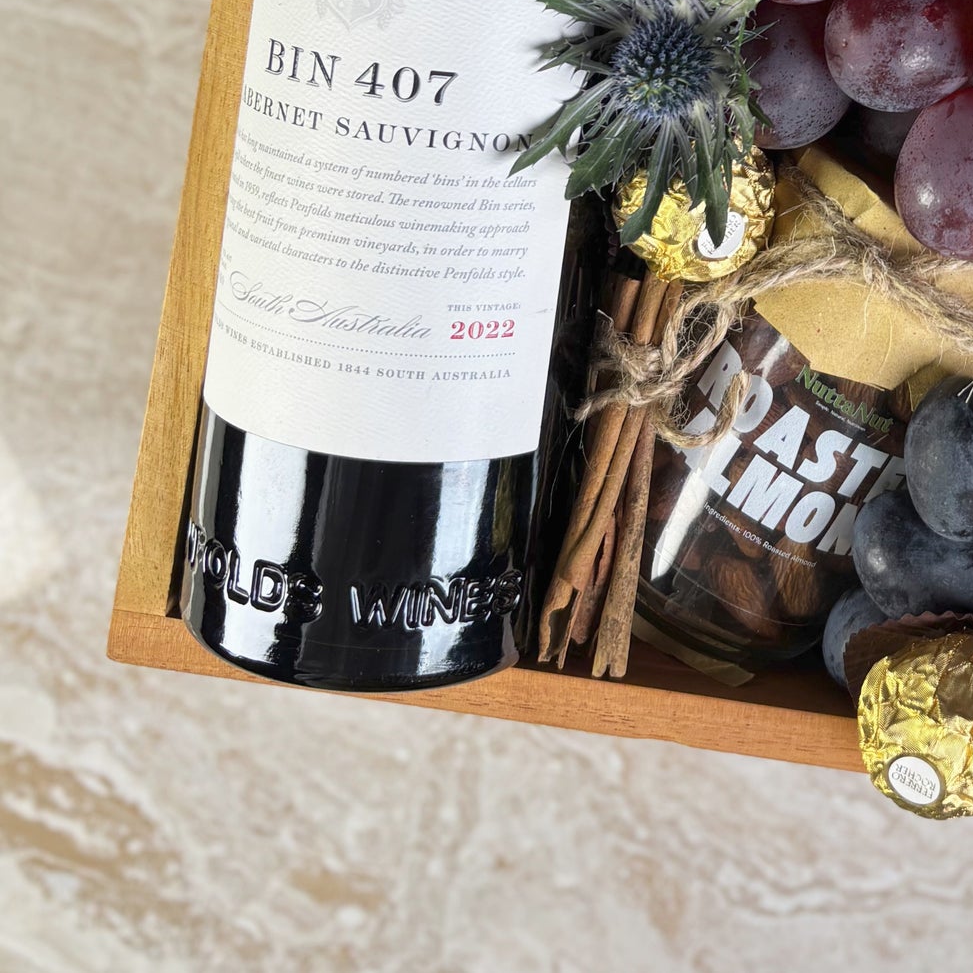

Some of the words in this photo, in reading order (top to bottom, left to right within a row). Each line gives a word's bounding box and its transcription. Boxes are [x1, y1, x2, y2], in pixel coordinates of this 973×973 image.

[265, 38, 342, 91] BIN
[354, 62, 459, 106] 407
[335, 116, 534, 152] SAUVIGNON
[252, 161, 264, 175] the
[261, 165, 285, 183] finest
[286, 176, 315, 190] wines
[317, 184, 344, 197] were
[345, 190, 385, 204] stored.
[388, 192, 410, 206] The
[412, 198, 477, 211] renowned
[478, 198, 500, 211] Bin
[502, 199, 537, 212] series,
[258, 143, 305, 164] maintained
[305, 158, 312, 166] a
[313, 159, 350, 175] system
[351, 165, 367, 180] of
[366, 169, 430, 185] numbered
[465, 175, 479, 187] in
[481, 176, 500, 189] the
[502, 176, 537, 188] cellars
[243, 203, 256, 218] best
[254, 210, 275, 226] fruit
[272, 217, 298, 233] from
[298, 226, 351, 246] premium
[353, 236, 420, 255] vineyards,
[423, 243, 437, 255] in
[440, 244, 475, 257] order
[477, 246, 488, 257] to
[490, 246, 528, 259] marry
[244, 180, 261, 199] 1959,
[261, 190, 289, 208] reflects
[290, 198, 332, 219] Penfolds
[334, 211, 396, 228] meticulous
[398, 219, 477, 238] winemaking
[479, 221, 530, 238] approach
[237, 227, 250, 240] and
[250, 233, 282, 253] varietal
[281, 243, 337, 266] characters
[336, 257, 347, 268] to
[350, 259, 369, 273] the
[371, 261, 441, 279] distinctive
[443, 266, 496, 283] Penfolds
[497, 266, 526, 283] style.
[230, 270, 294, 315] South
[288, 299, 432, 340] Australia
[447, 304, 472, 312] THIS
[450, 319, 516, 340] 2022
[225, 324, 248, 345] WINES
[250, 338, 332, 369] ESTABLISHED
[337, 362, 370, 376] 1844
[376, 367, 425, 380] SOUTH
[431, 369, 511, 381] AUSTRALIA
[697, 340, 907, 504] ROASTE
[795, 364, 894, 433] NuttaNut
[672, 407, 858, 556] ALMON
[703, 502, 741, 534] Ingredients:
[742, 530, 762, 546] 100%
[762, 540, 791, 559] Roasted
[790, 554, 817, 568] Almond
[350, 569, 523, 630] WINES
[891, 771, 933, 800] FERRERO
[895, 763, 937, 791] ROCHER
